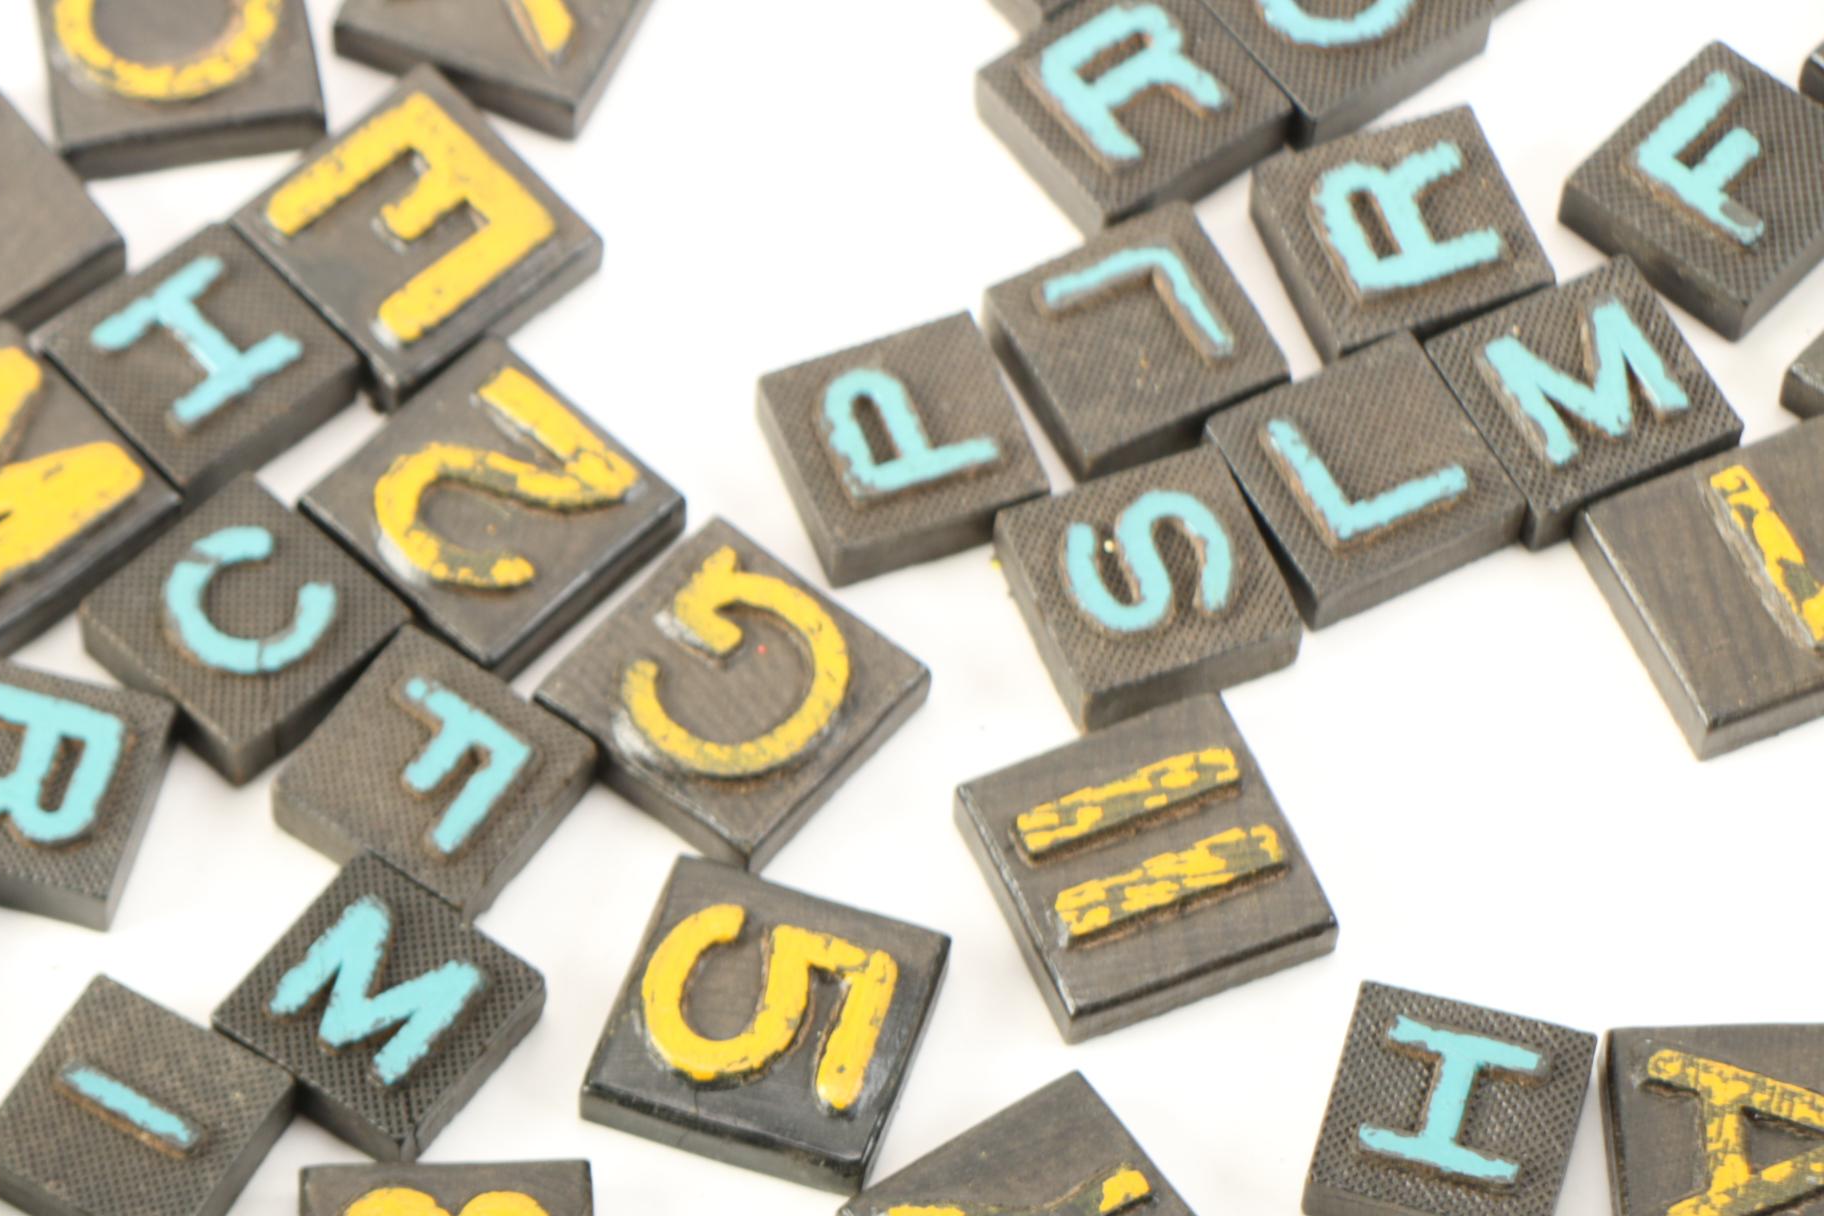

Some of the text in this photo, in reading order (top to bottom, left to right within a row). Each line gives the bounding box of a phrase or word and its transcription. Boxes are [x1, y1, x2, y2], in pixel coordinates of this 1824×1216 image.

[1040, 3, 1224, 160] R
[1632, 70, 1766, 246] F
[268, 92, 556, 342] E
[1314, 140, 1502, 290] R
[824, 370, 996, 490] P
[1484, 300, 1688, 464] M
[1064, 484, 1234, 632] S
[1267, 418, 1467, 540] L
[166, 526, 335, 676] C
[404, 677, 530, 852] F
[269, 896, 480, 1085] M
[640, 903, 901, 1113] 5
